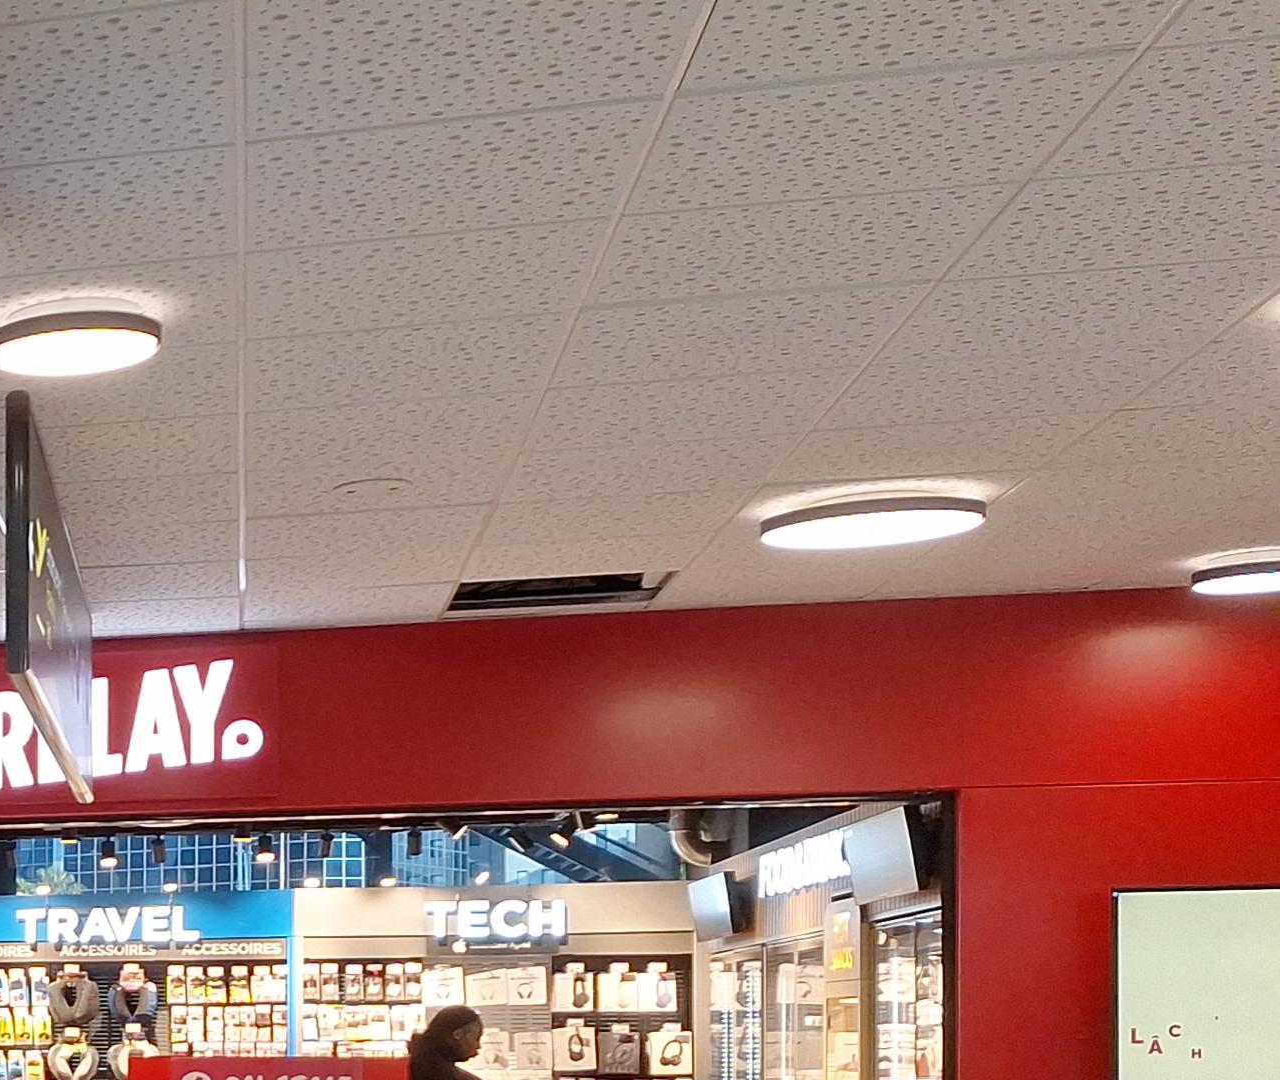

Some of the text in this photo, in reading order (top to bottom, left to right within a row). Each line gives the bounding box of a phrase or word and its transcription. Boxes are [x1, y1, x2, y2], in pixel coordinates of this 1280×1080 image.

[16, 907, 202, 945] TRAVEL
[423, 899, 567, 938] TECH
[59, 944, 157, 957] ACCESSOIRES
[181, 942, 283, 956] ACCESSOIRES
